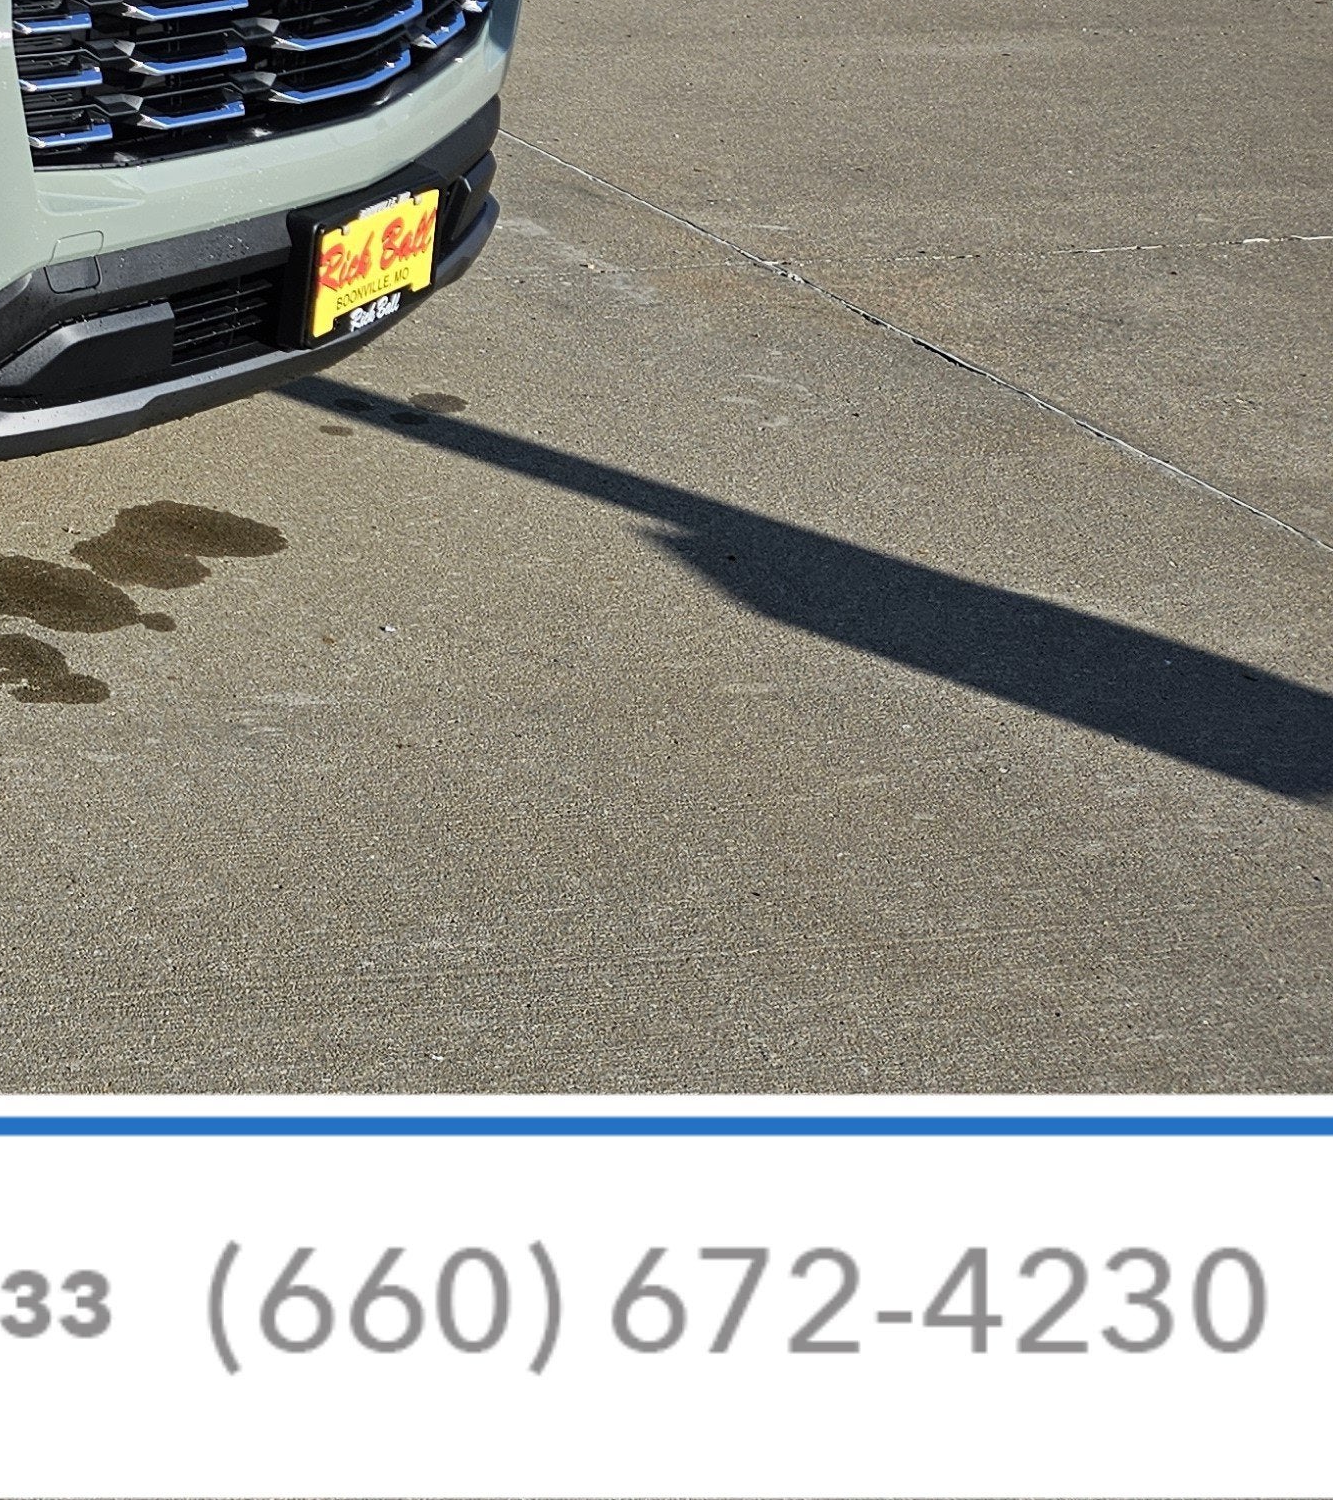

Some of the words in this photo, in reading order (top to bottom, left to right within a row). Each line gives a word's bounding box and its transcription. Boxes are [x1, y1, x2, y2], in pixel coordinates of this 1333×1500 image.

[313, 230, 375, 293] Rick
[380, 207, 438, 271] Ball
[336, 275, 392, 311] BOONVILLE,
[394, 266, 410, 283] MO
[349, 301, 376, 332] Rick
[376, 292, 402, 319] Ball
